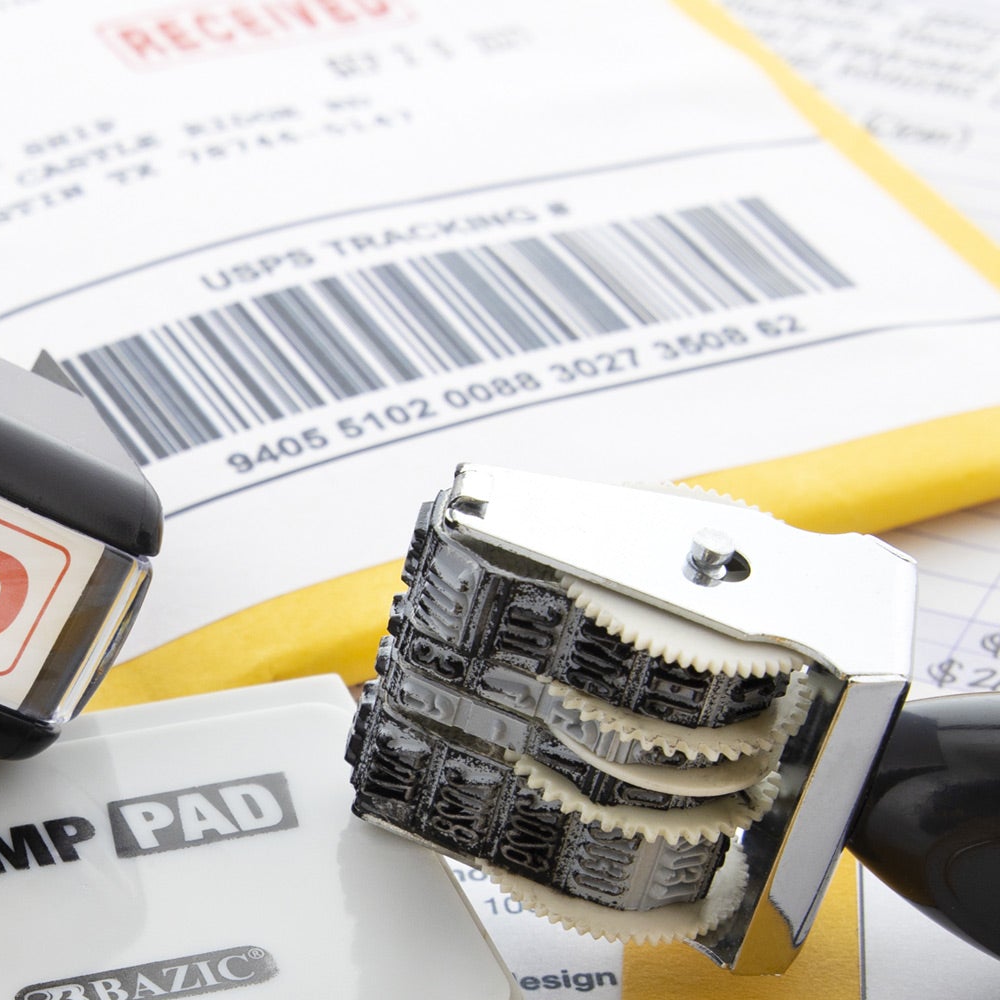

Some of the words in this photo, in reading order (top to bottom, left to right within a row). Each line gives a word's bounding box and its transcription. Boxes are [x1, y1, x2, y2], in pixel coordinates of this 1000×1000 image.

[200, 247, 314, 292] USPS
[324, 207, 538, 260] TRACKING
[226, 427, 329, 474] 9405
[336, 399, 437, 441] 5102
[442, 370, 542, 412] 0088
[548, 347, 641, 382] 3027
[653, 325, 750, 361] 3508
[754, 313, 807, 338] 62
[117, 783, 285, 850] PAD
[511, 969, 619, 993] esign
